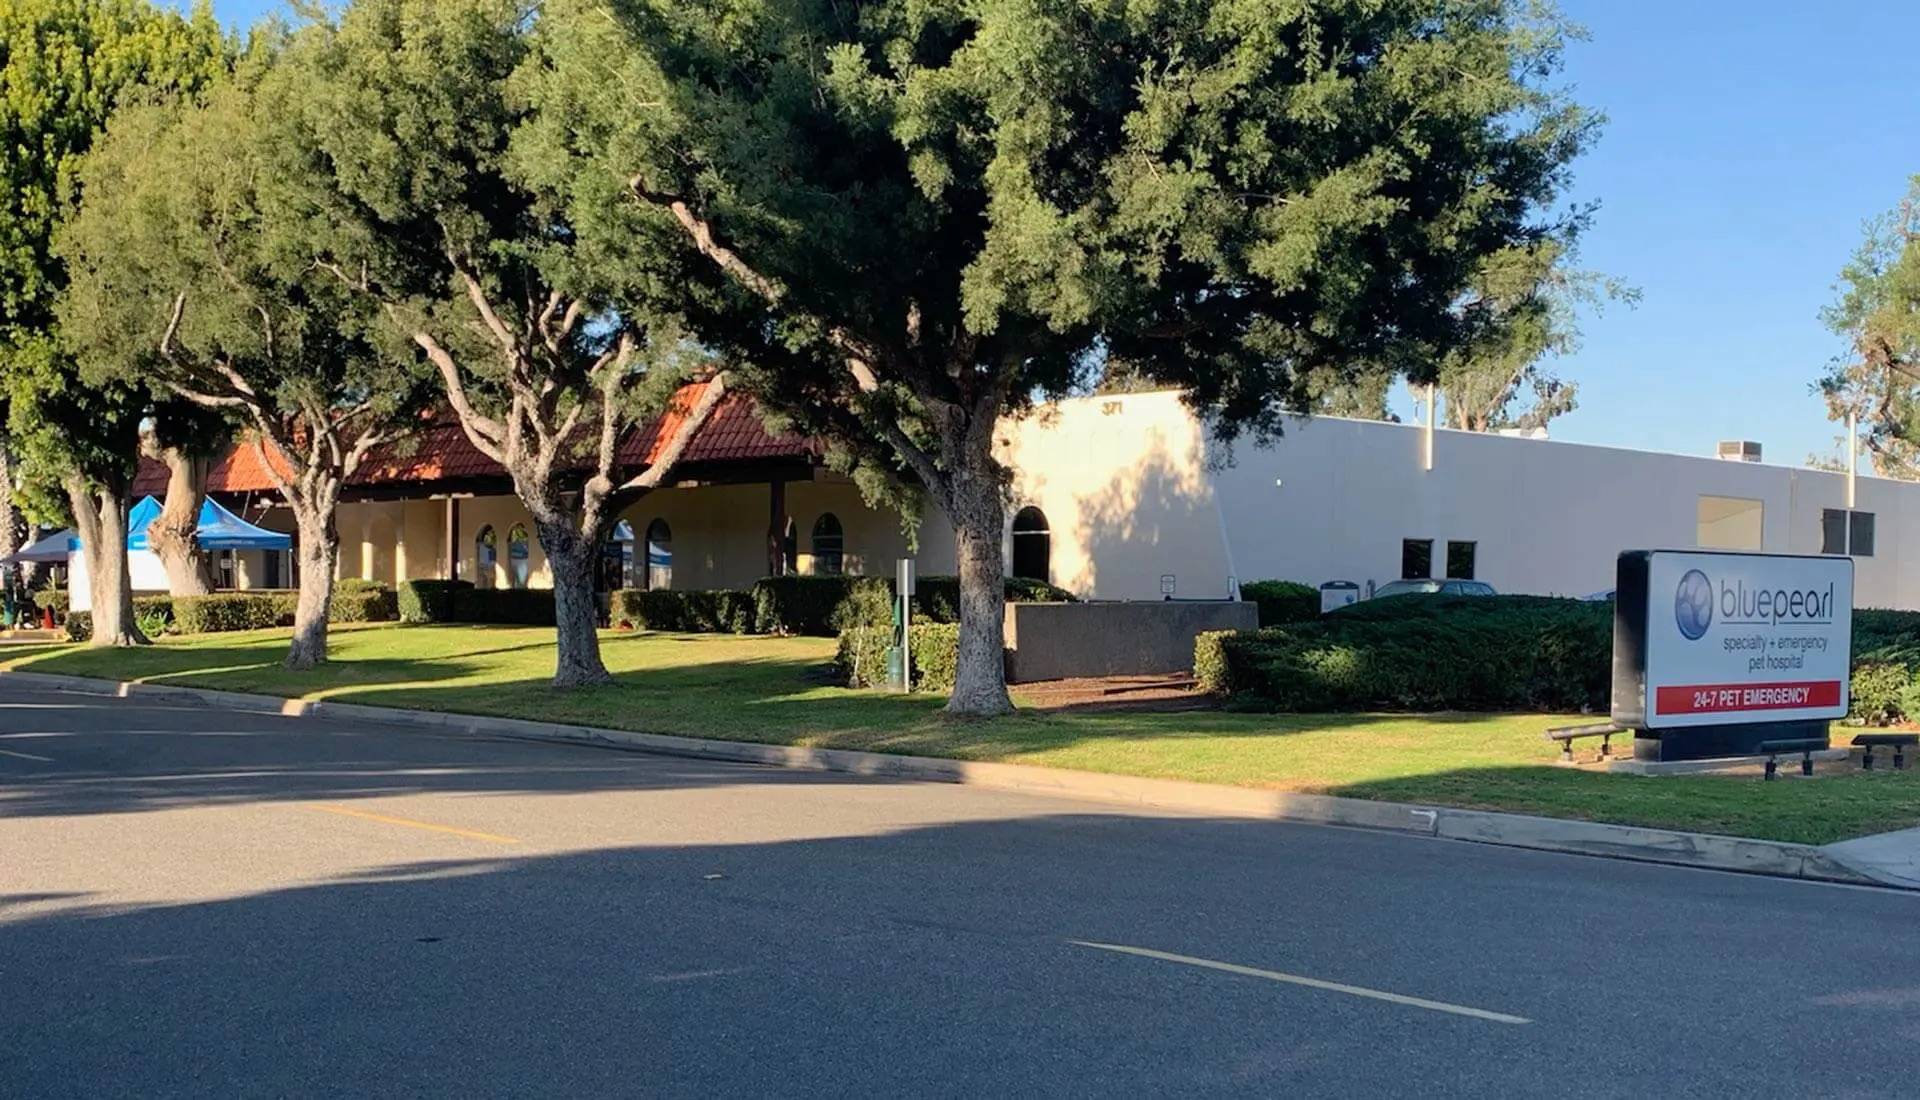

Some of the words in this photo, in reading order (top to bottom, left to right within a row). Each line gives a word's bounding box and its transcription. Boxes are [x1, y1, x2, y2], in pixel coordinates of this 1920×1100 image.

[1720, 579, 1834, 626] bluepearl
[1723, 634, 1767, 653] specialty
[1777, 635, 1828, 653] emergency
[1748, 655, 1765, 674] pet
[1766, 654, 1804, 672] hospital
[1693, 690, 1718, 709] 24-7
[1719, 690, 1741, 706] PET
[1743, 687, 1810, 705] EMERGENCY
